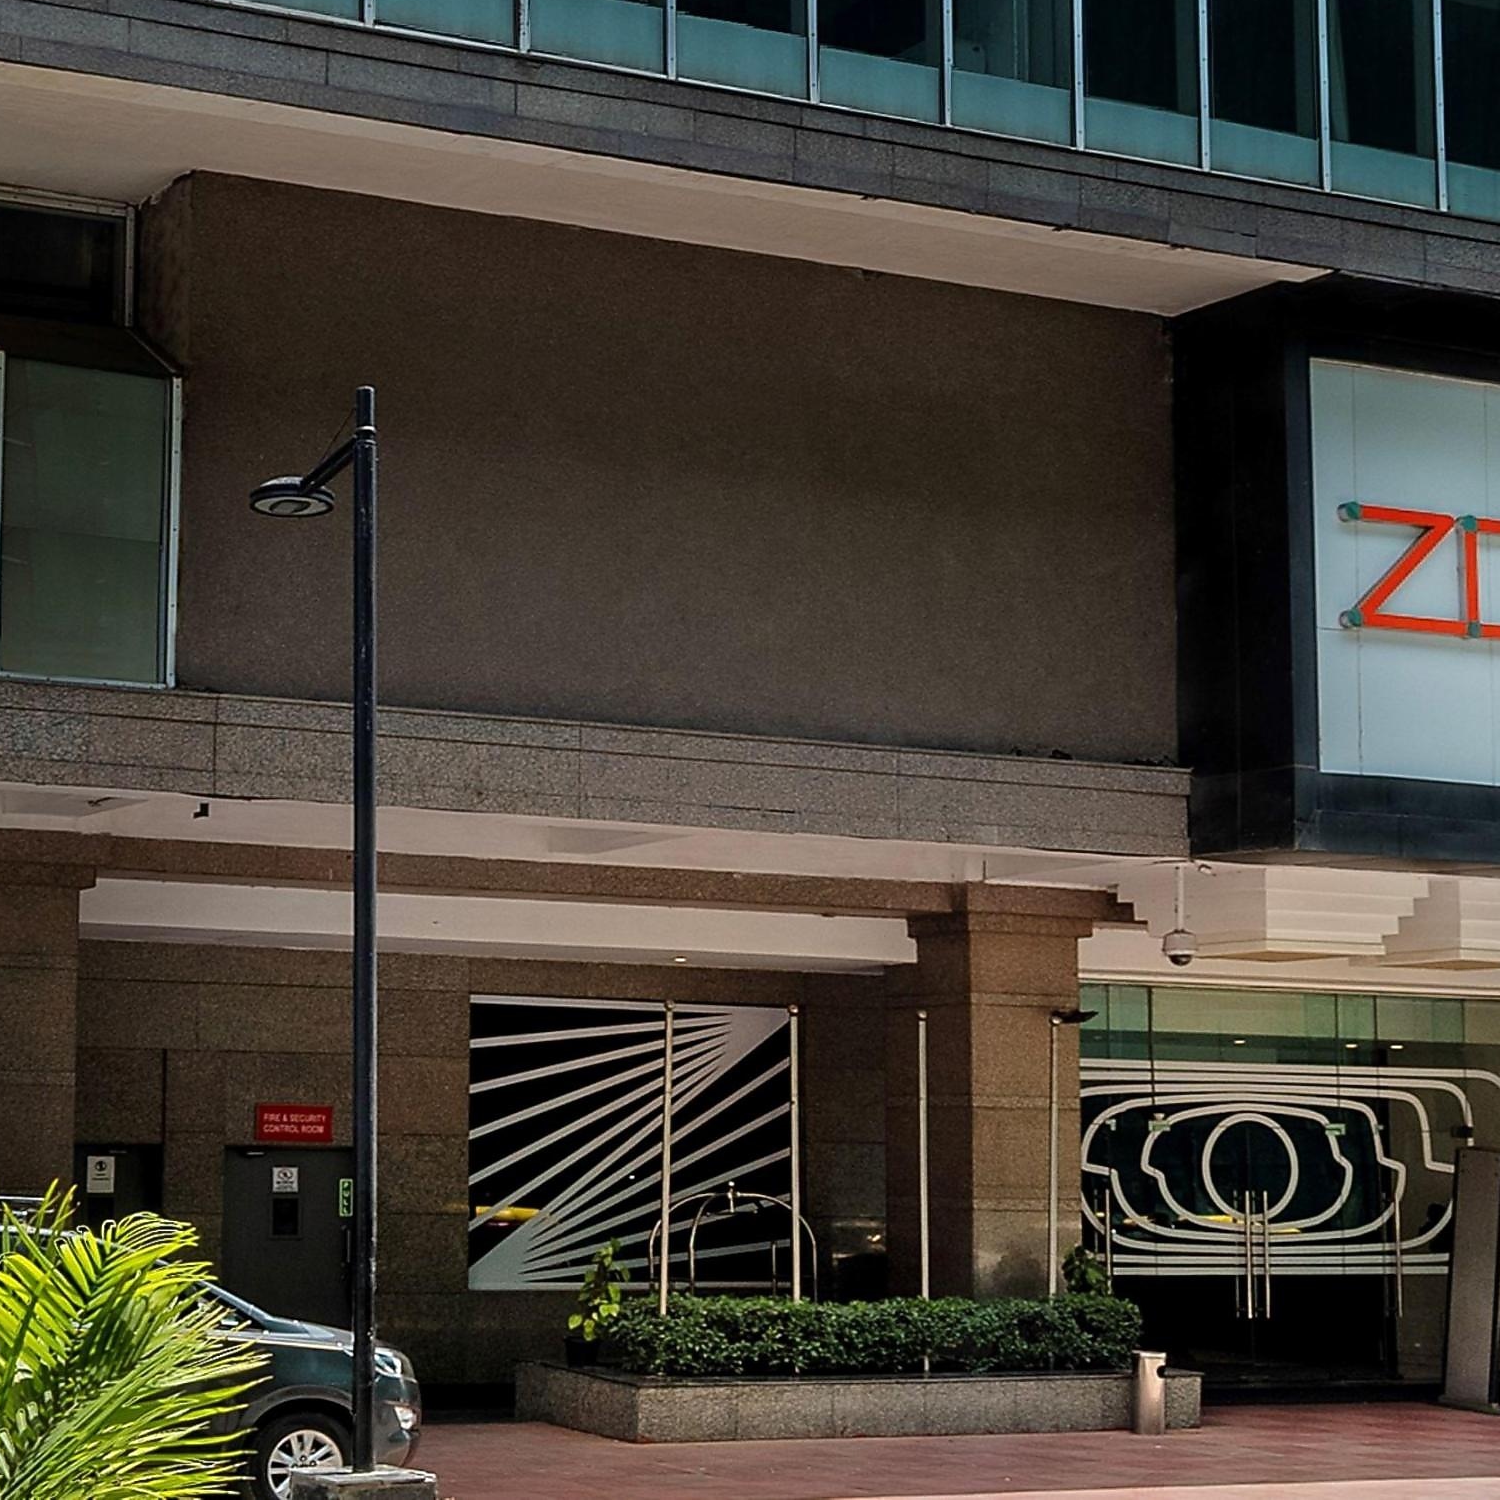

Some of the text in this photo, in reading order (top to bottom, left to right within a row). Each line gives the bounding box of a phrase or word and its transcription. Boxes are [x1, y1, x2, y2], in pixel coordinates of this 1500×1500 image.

[263, 1113, 327, 1123] FIRE & SECURITY
[263, 1124, 325, 1134] CONTROL ROOM
